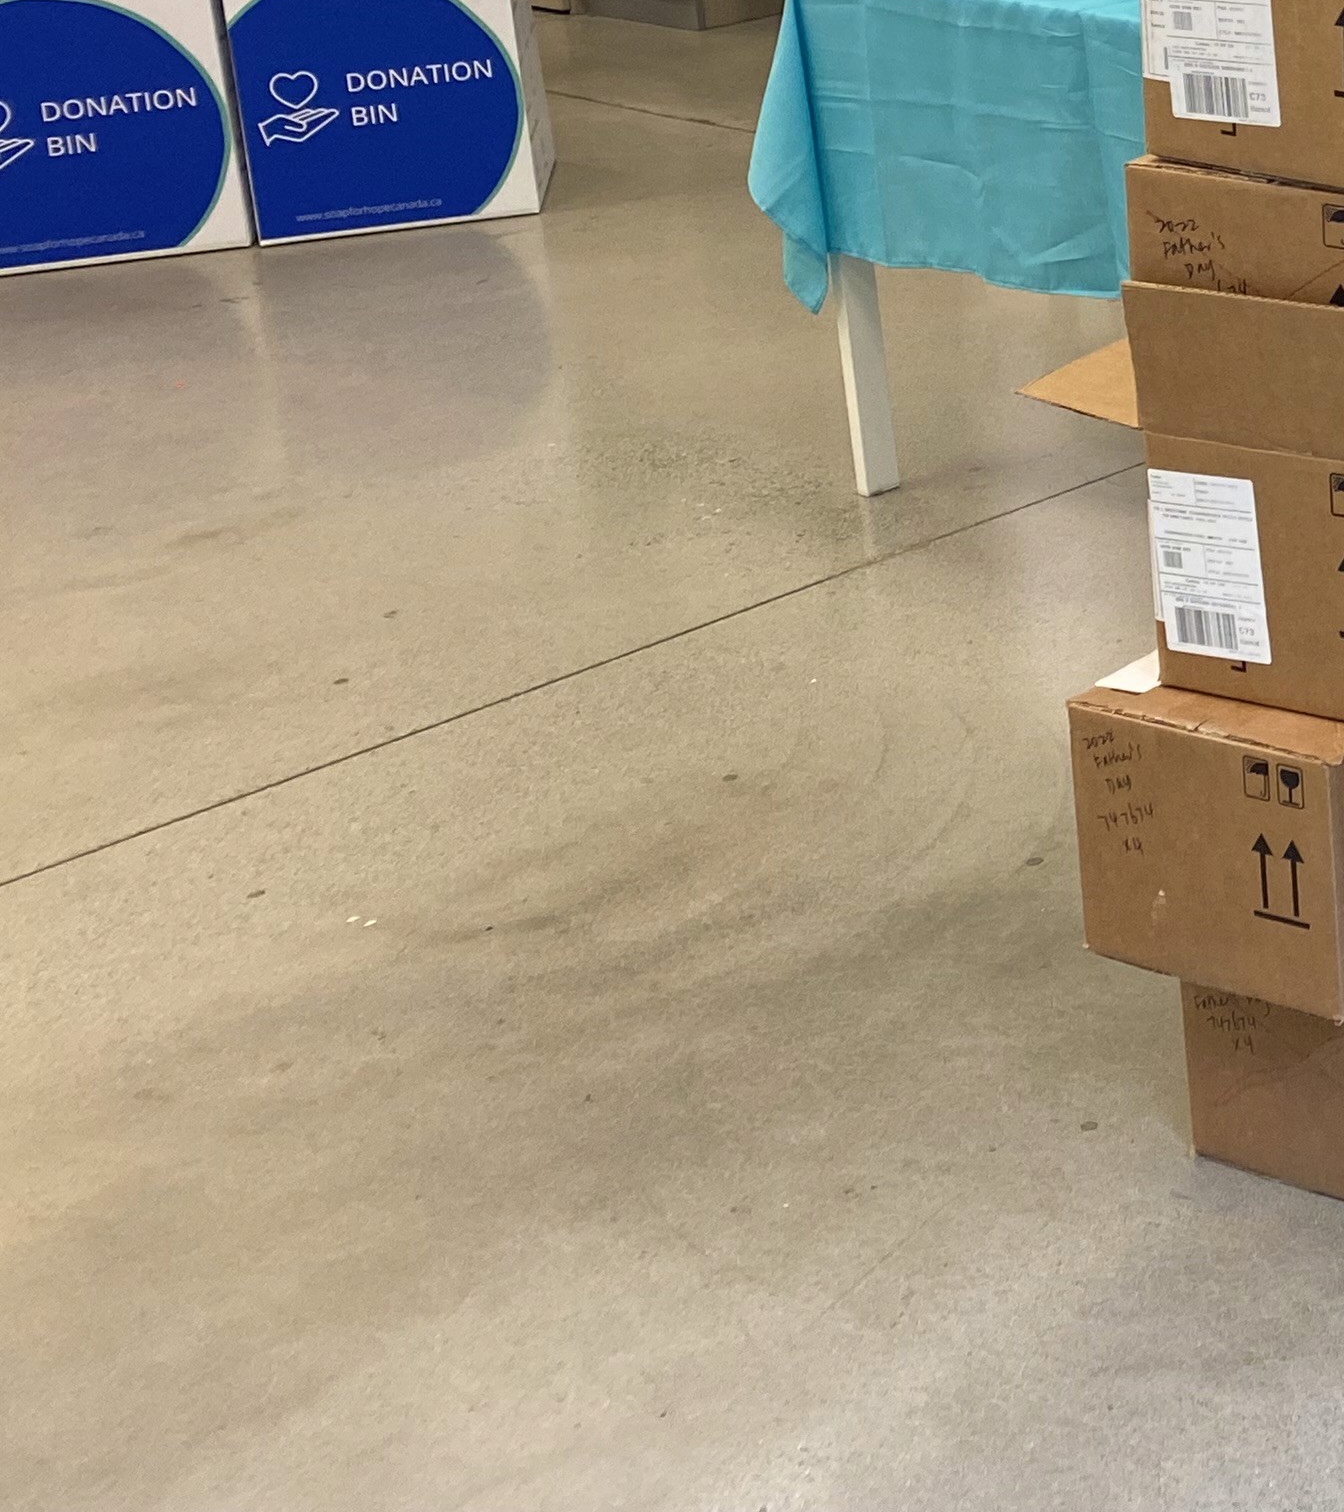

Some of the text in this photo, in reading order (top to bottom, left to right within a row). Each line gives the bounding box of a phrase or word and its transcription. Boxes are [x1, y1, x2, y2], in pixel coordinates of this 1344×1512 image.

[345, 59, 493, 93] DONATION
[41, 87, 197, 123] DONATION
[350, 102, 399, 127] BIN
[47, 133, 97, 157] BIN
